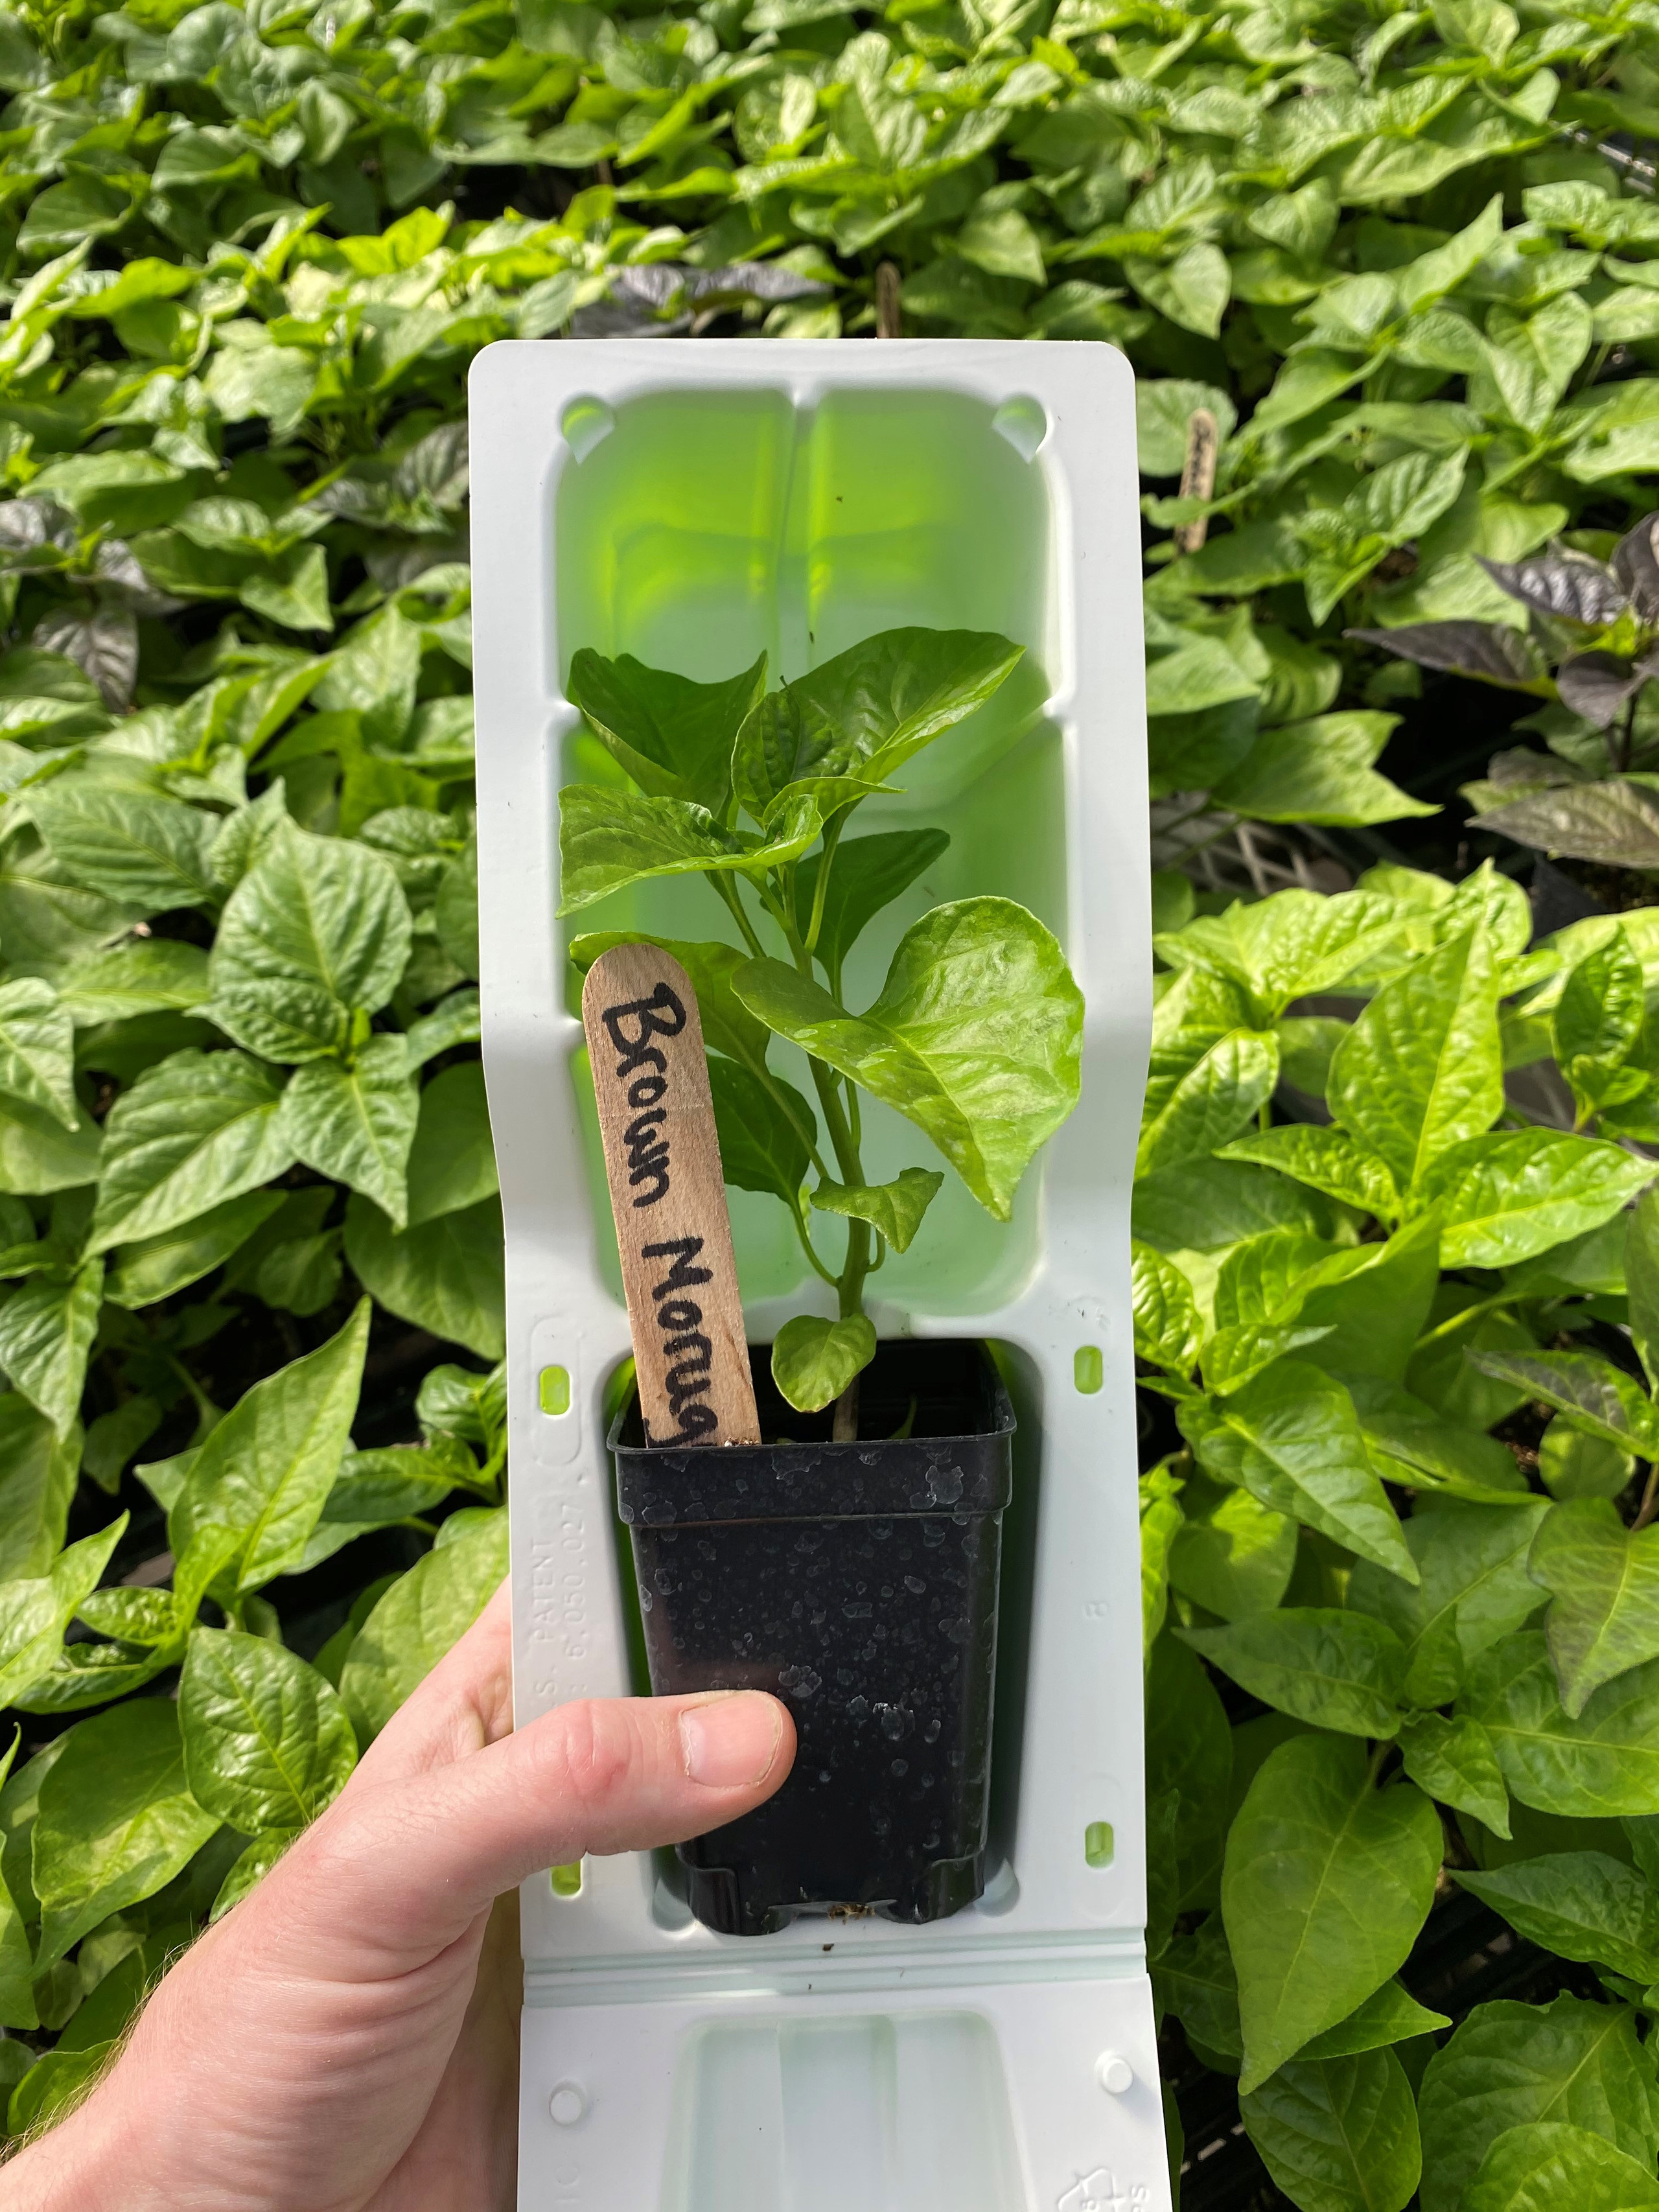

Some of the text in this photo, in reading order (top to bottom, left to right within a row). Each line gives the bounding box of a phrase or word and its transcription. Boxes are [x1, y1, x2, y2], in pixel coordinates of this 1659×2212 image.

[602, 981, 718, 1447] Brown Morug
[530, 1537, 555, 1642] PATENT
